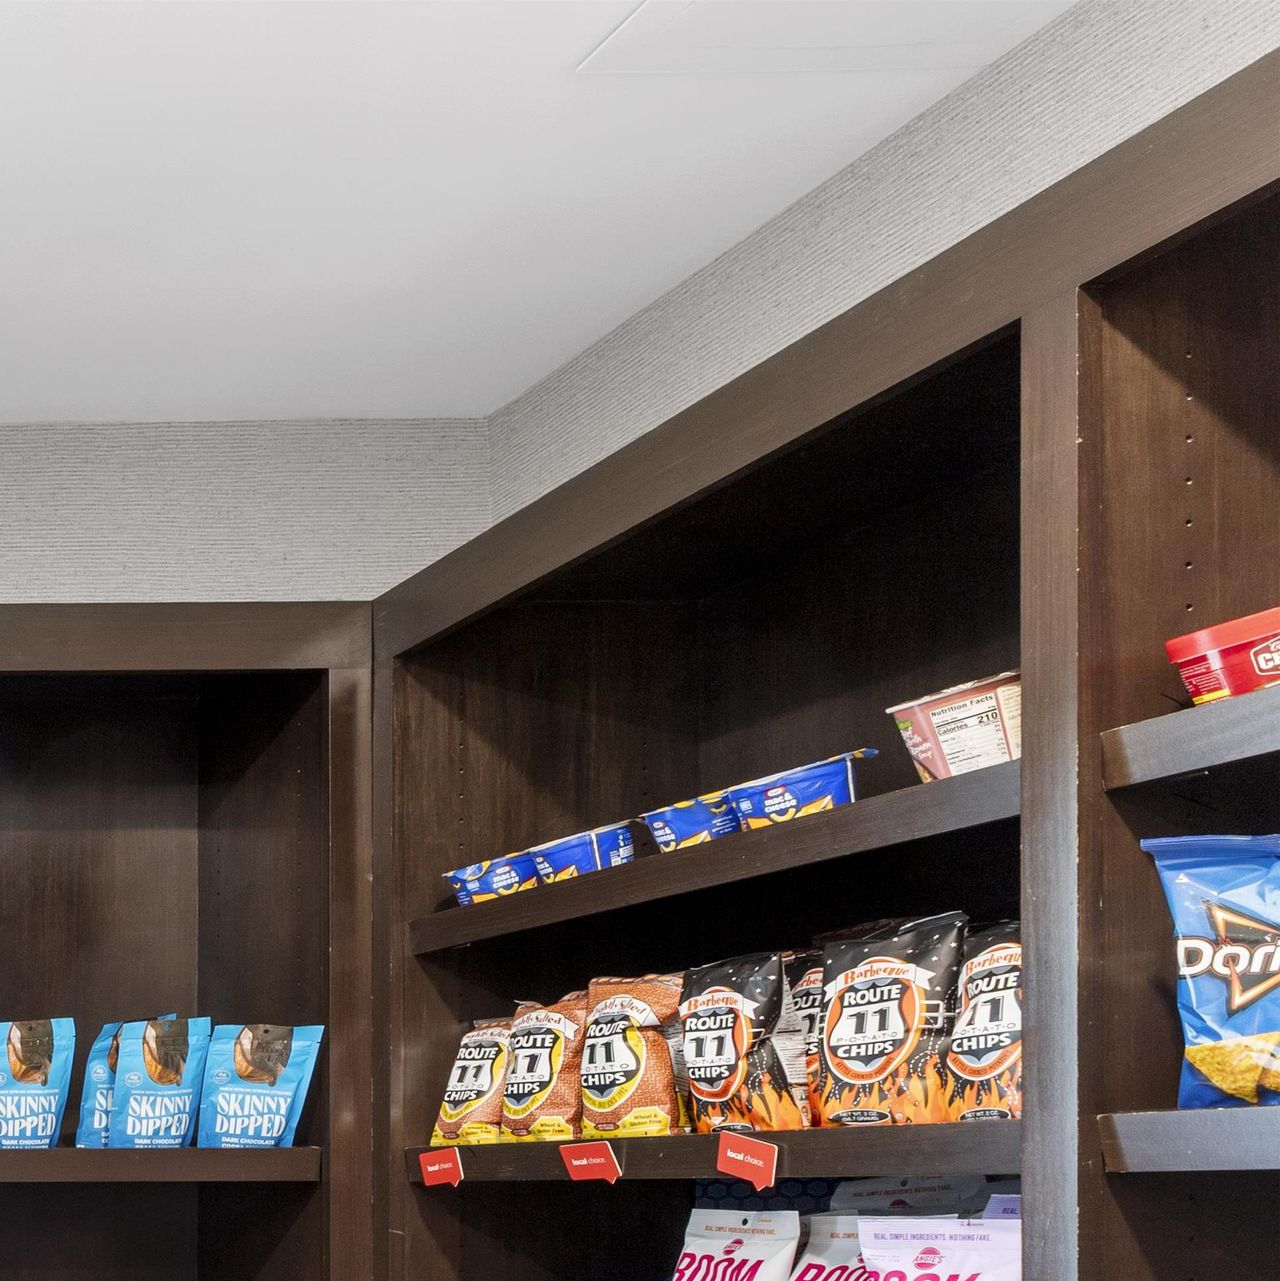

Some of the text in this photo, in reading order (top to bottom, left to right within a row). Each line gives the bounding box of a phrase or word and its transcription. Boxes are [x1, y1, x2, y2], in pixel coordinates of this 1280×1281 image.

[931, 695, 994, 717] Nutrition Facts
[938, 711, 998, 736] Calories 210
[843, 964, 909, 985] Barbeque
[967, 972, 1020, 998] ROUTE
[687, 994, 739, 1012] Barbeque
[843, 984, 903, 1006] ROUTE
[966, 995, 1004, 1026] 11
[586, 1020, 629, 1037] ROUTE
[685, 1014, 735, 1031] ROUTE
[846, 1006, 890, 1035] 11
[690, 1033, 728, 1058] 11
[836, 1040, 894, 1058] CHIPS
[951, 1033, 1012, 1052] CHIPS
[457, 1047, 499, 1060] ROUTE
[581, 1072, 626, 1087] CHIPS
[688, 1066, 730, 1079] CHIPS
[444, 1089, 478, 1101] CHIPS
[504, 1082, 540, 1094] CHIPS
[128, 1094, 192, 1117] SKINNY
[216, 1092, 291, 1118] SKINNY
[126, 1113, 189, 1136] DIPPED
[215, 1113, 286, 1137] DIPPED
[571, 1157, 588, 1167] local
[727, 1148, 744, 1161] local
[427, 1163, 440, 1172] local
[888, 1233, 909, 1241] SIMPLE
[948, 1233, 975, 1241] NOTHING
[912, 1255, 947, 1264] ANGIE'S
